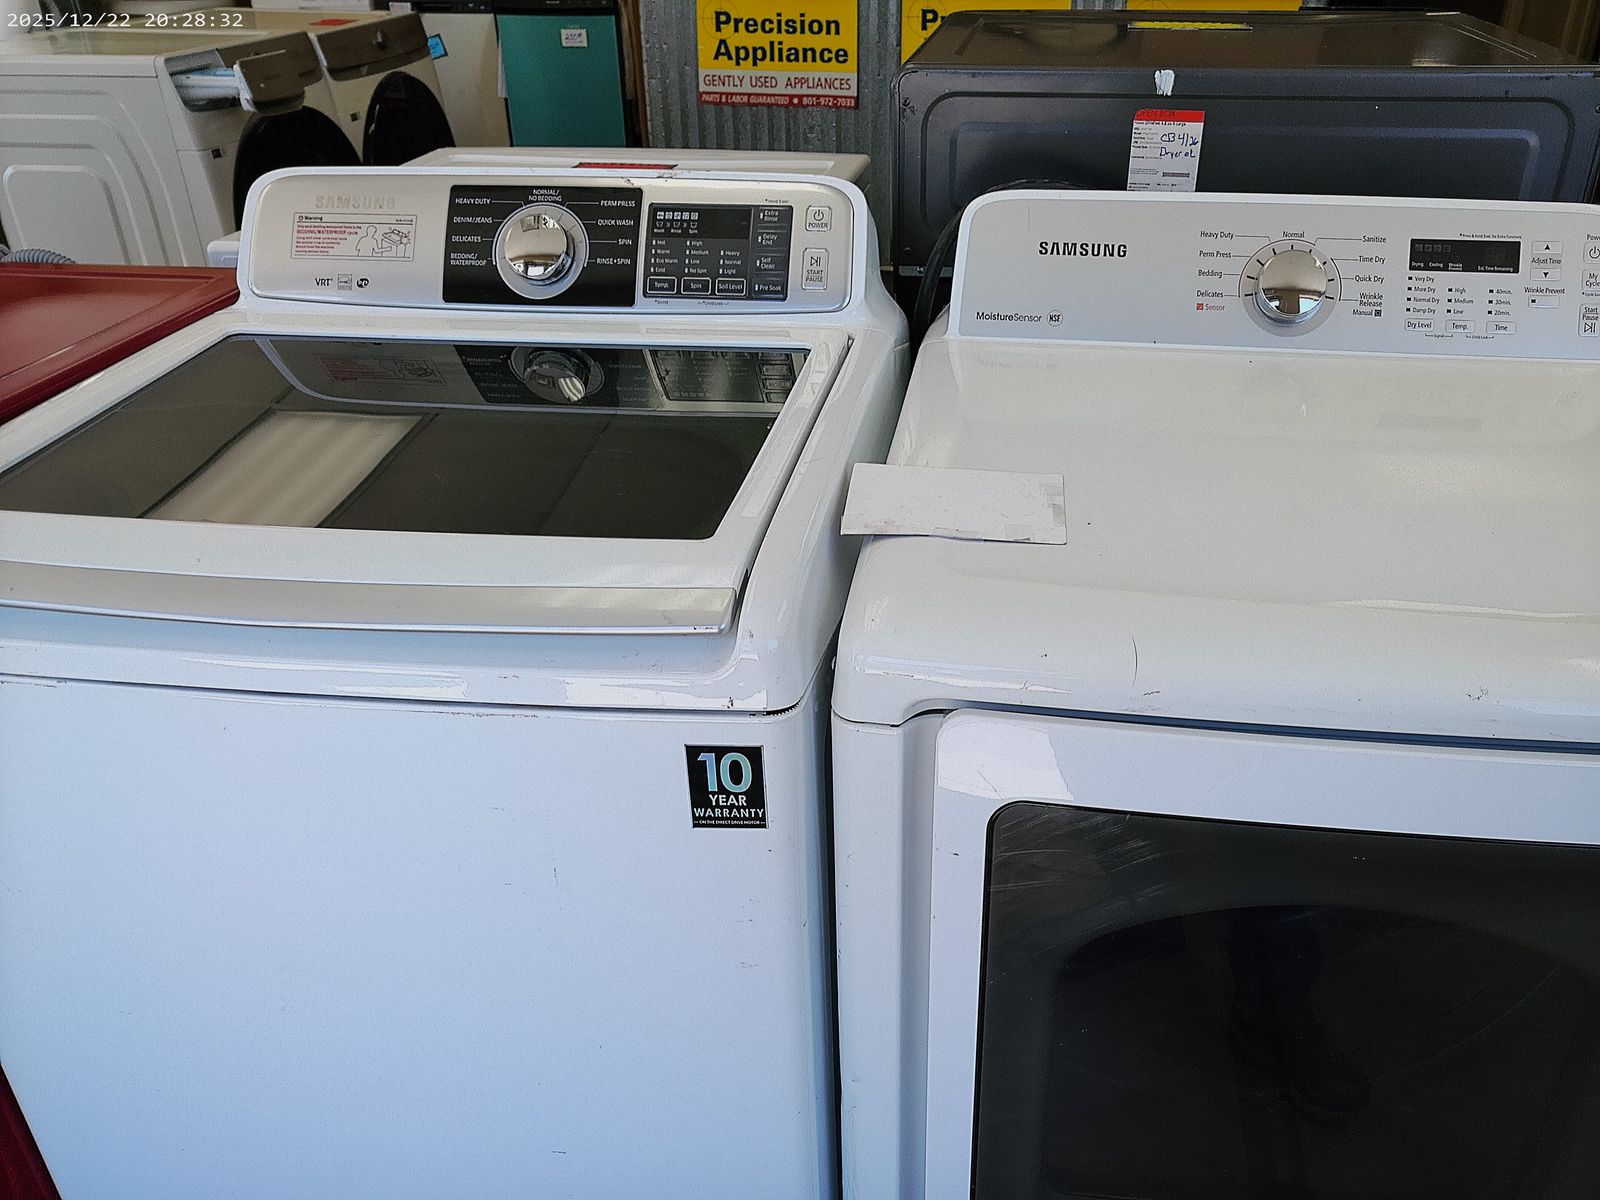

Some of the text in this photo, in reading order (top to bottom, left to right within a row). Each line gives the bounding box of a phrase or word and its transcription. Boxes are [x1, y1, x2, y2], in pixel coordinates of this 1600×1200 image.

[715, 11, 840, 36] Precision
[713, 40, 849, 66] Appliance
[703, 75, 851, 91] GENTLY USED APPLIANCES
[702, 94, 719, 103] PARTS
[728, 95, 747, 104] LABOR
[749, 96, 789, 105] GUARANTEED
[802, 97, 855, 107] 801-972-7033
[315, 195, 395, 209] SAMSUNG
[1200, 231, 1218, 239] Heavy
[1039, 241, 1128, 258] SAMSUNG
[1374, 256, 1385, 264] Dry
[1198, 270, 1223, 278] Bedding
[1355, 275, 1384, 284] Quick Dry
[1197, 290, 1223, 298] Delicates
[976, 311, 1042, 323] MoistureSensor
[697, 752, 752, 792] 10
[709, 795, 747, 806] YEAR
[694, 808, 764, 817] WARRANTY
